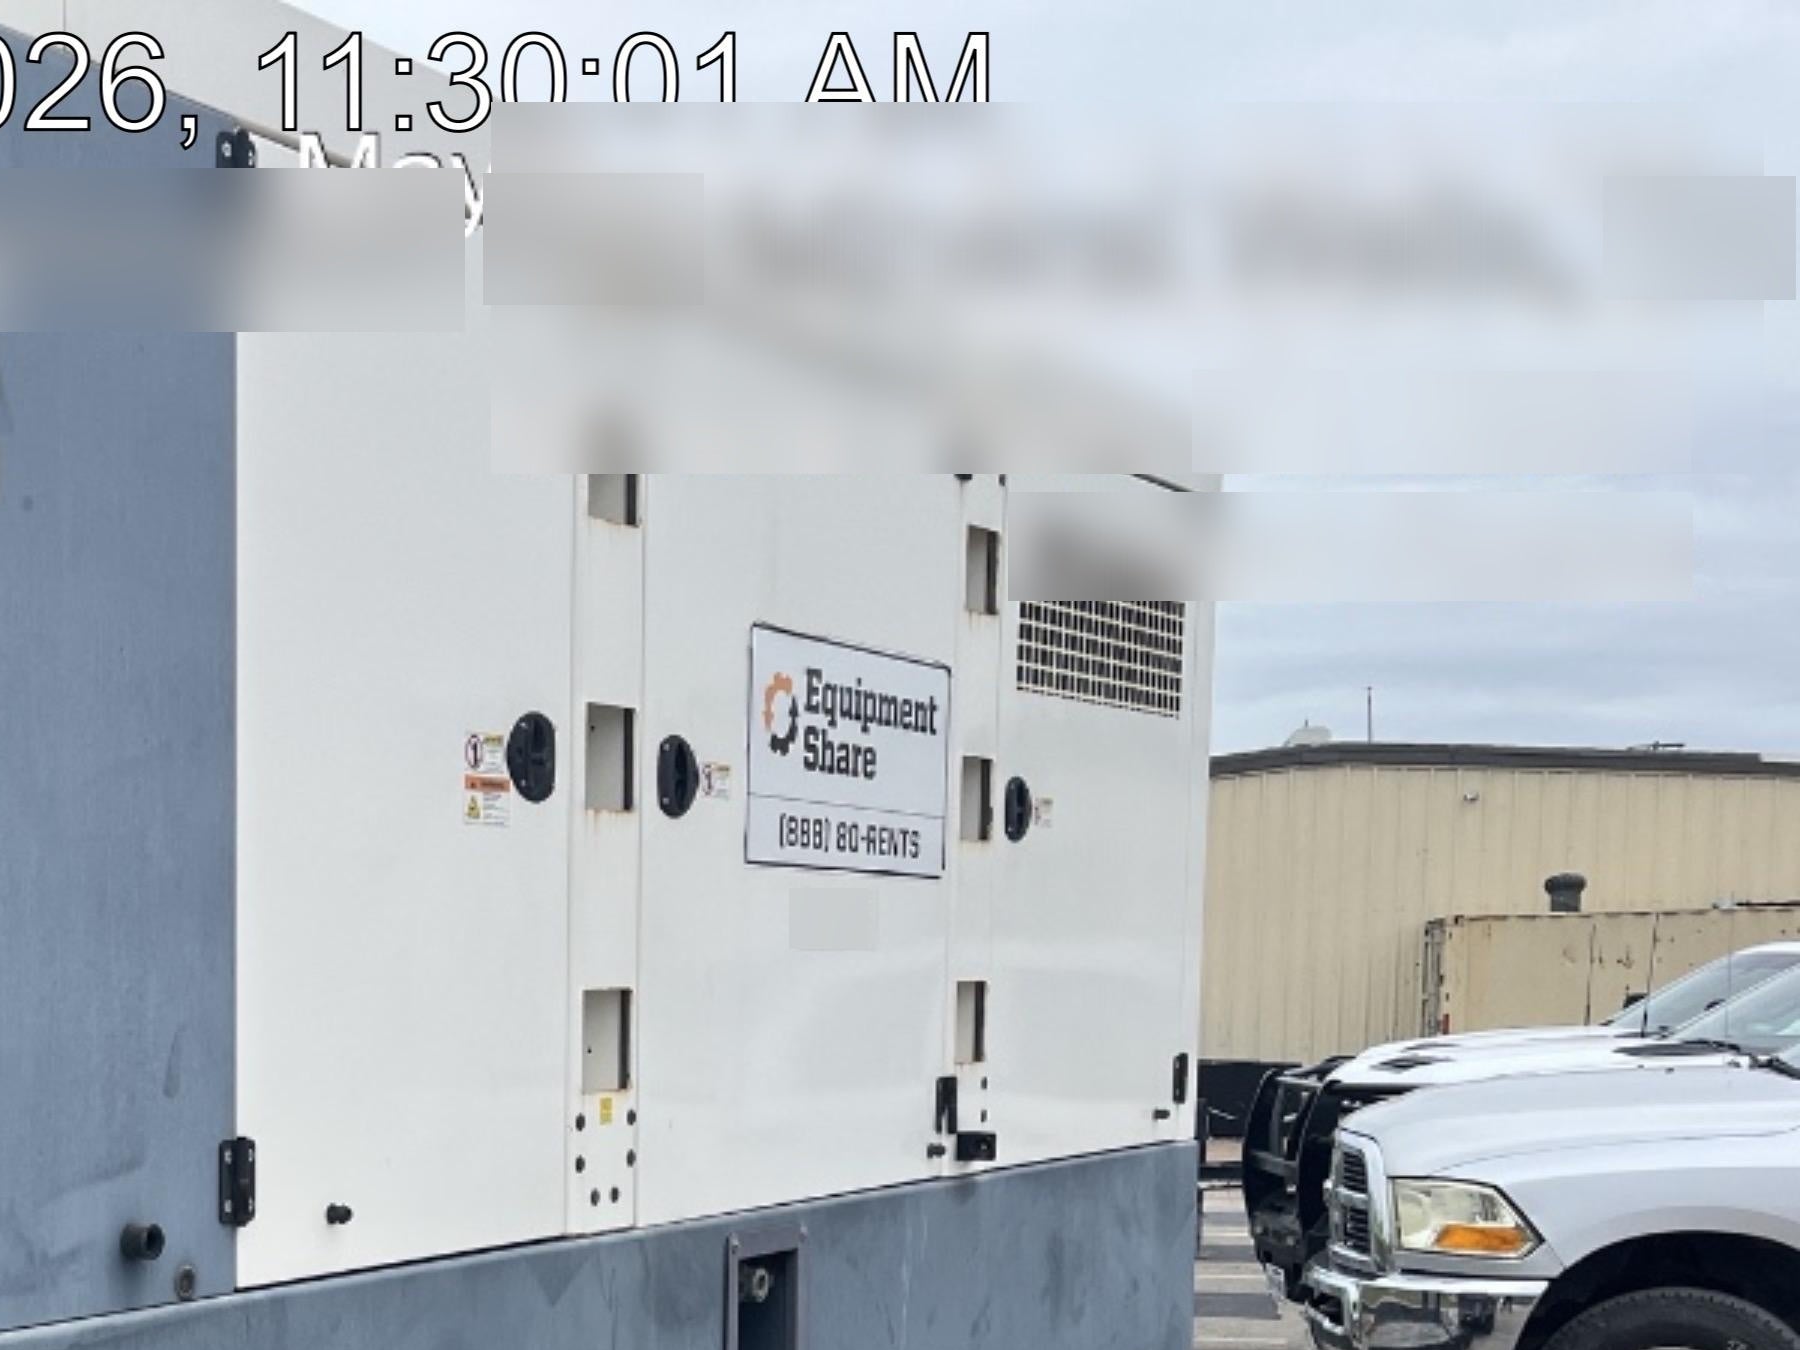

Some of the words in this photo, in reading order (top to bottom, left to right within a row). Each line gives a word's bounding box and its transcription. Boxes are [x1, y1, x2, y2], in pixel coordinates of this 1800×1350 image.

[803, 667, 939, 736] Equipment
[803, 725, 877, 780] Share
[778, 812, 831, 853] (888)
[835, 821, 921, 860] 80-RENTS
